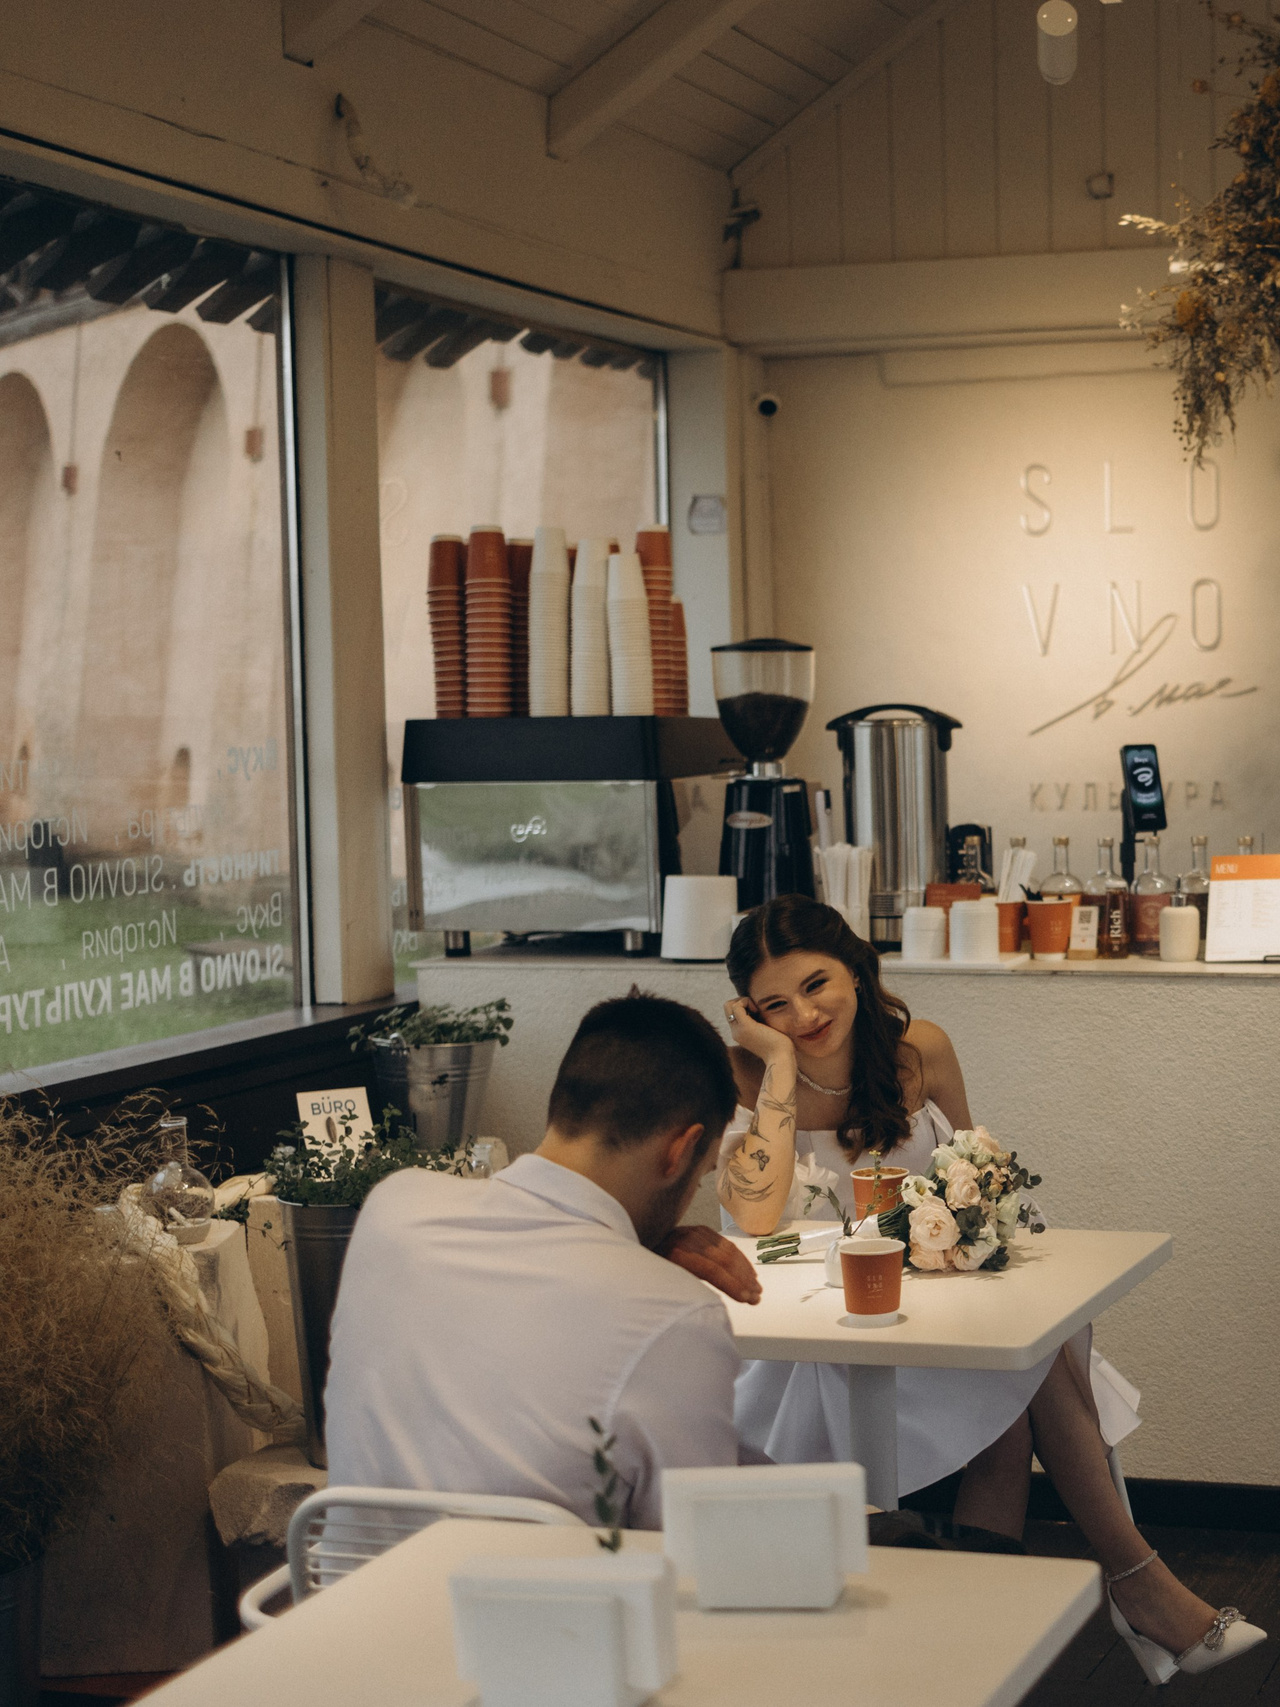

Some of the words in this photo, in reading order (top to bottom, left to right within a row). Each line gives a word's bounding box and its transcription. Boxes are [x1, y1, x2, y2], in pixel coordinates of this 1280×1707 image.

[1215, 863, 1239, 874] MENU
[1110, 909, 1121, 938] Rich
[310, 1095, 357, 1116] BÜRO
